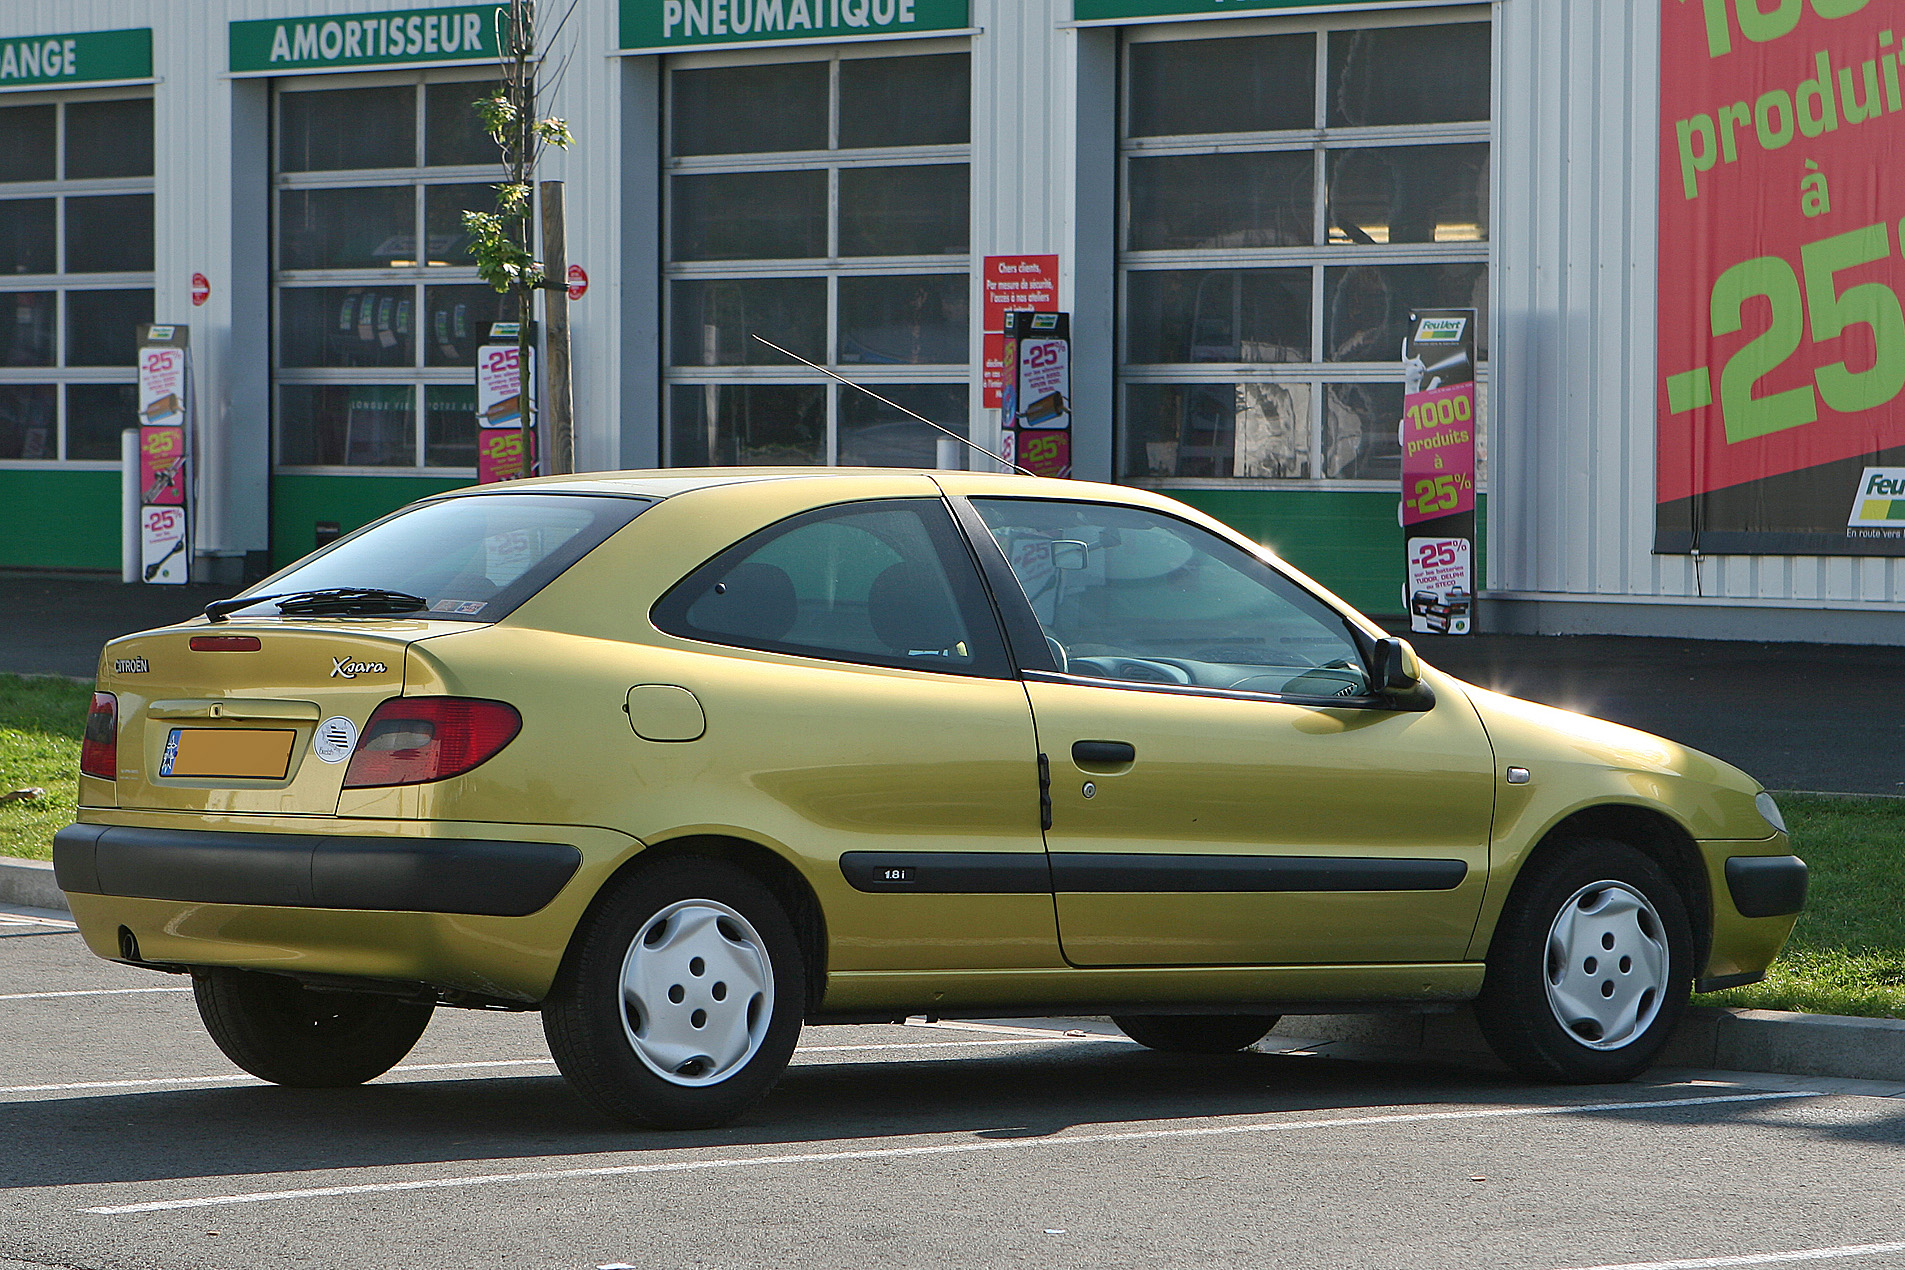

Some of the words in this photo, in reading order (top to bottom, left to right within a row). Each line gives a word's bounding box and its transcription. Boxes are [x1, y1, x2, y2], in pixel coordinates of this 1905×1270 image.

[663, 0, 915, 38] PNEUMATIQUE
[270, 13, 483, 62] AMORTISSEUR
[1675, 29, 1905, 200] produi
[1801, 158, 1831, 218] à
[1666, 215, 1905, 445] -25
[1023, 341, 1067, 369] -25%
[1407, 395, 1471, 430] 1000
[1021, 434, 1068, 462] -25%
[1407, 428, 1469, 457] produits
[1434, 453, 1443, 469] à
[1407, 472, 1472, 514] -25%
[144, 509, 182, 532] -25%
[1847, 527, 1857, 538] En
[1859, 528, 1881, 538] route
[1412, 539, 1467, 569] -25%
[114, 655, 149, 673] CITROËN
[330, 655, 388, 679] Xsara
